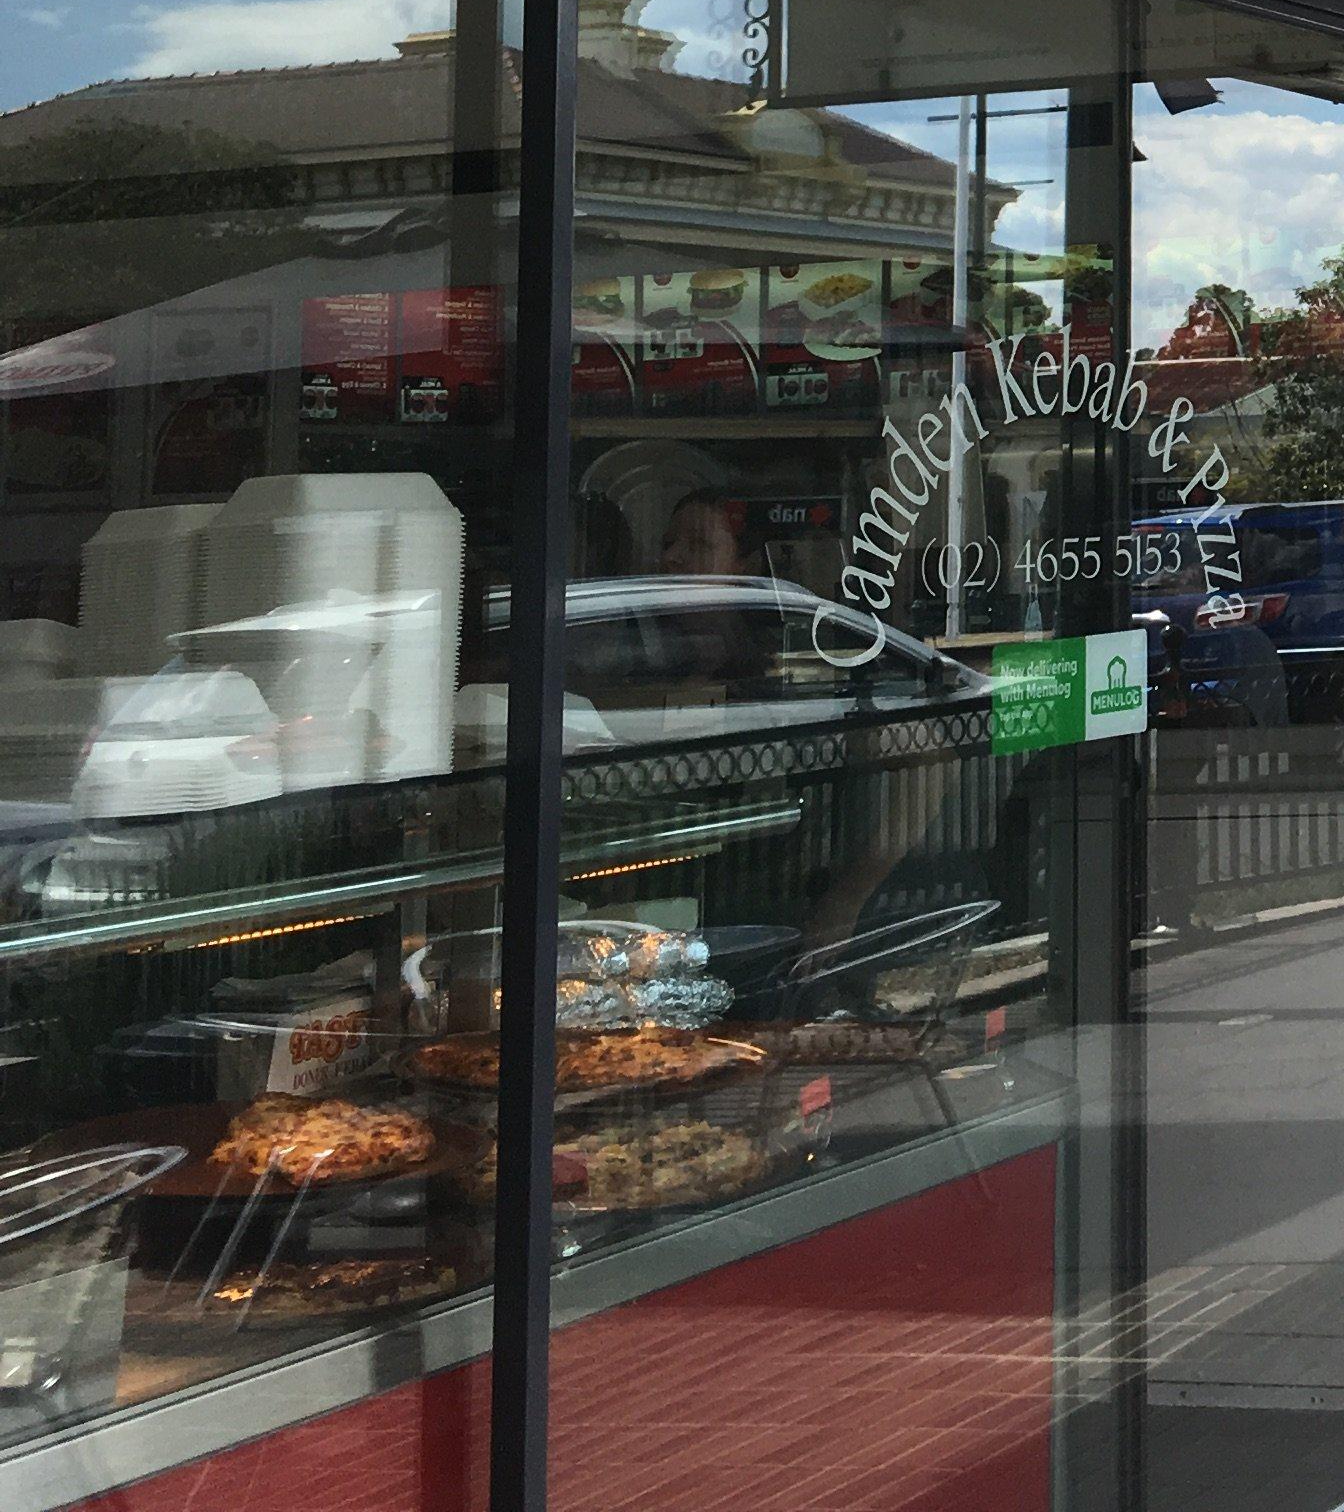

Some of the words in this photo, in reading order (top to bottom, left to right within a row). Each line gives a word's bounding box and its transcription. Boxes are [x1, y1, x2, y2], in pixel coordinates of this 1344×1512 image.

[812, 382, 988, 668] Camden
[986, 324, 1148, 432] Kebab
[1149, 396, 1193, 472] &
[1177, 443, 1246, 630] Pizza
[922, 536, 1001, 597] (02)
[1015, 536, 1101, 583] 4655
[1112, 533, 1181, 578] 5153
[1026, 657, 1078, 677] delivering
[1000, 684, 1024, 703] with
[1026, 682, 1071, 700] Menulog
[1092, 690, 1140, 710] MENULOG
